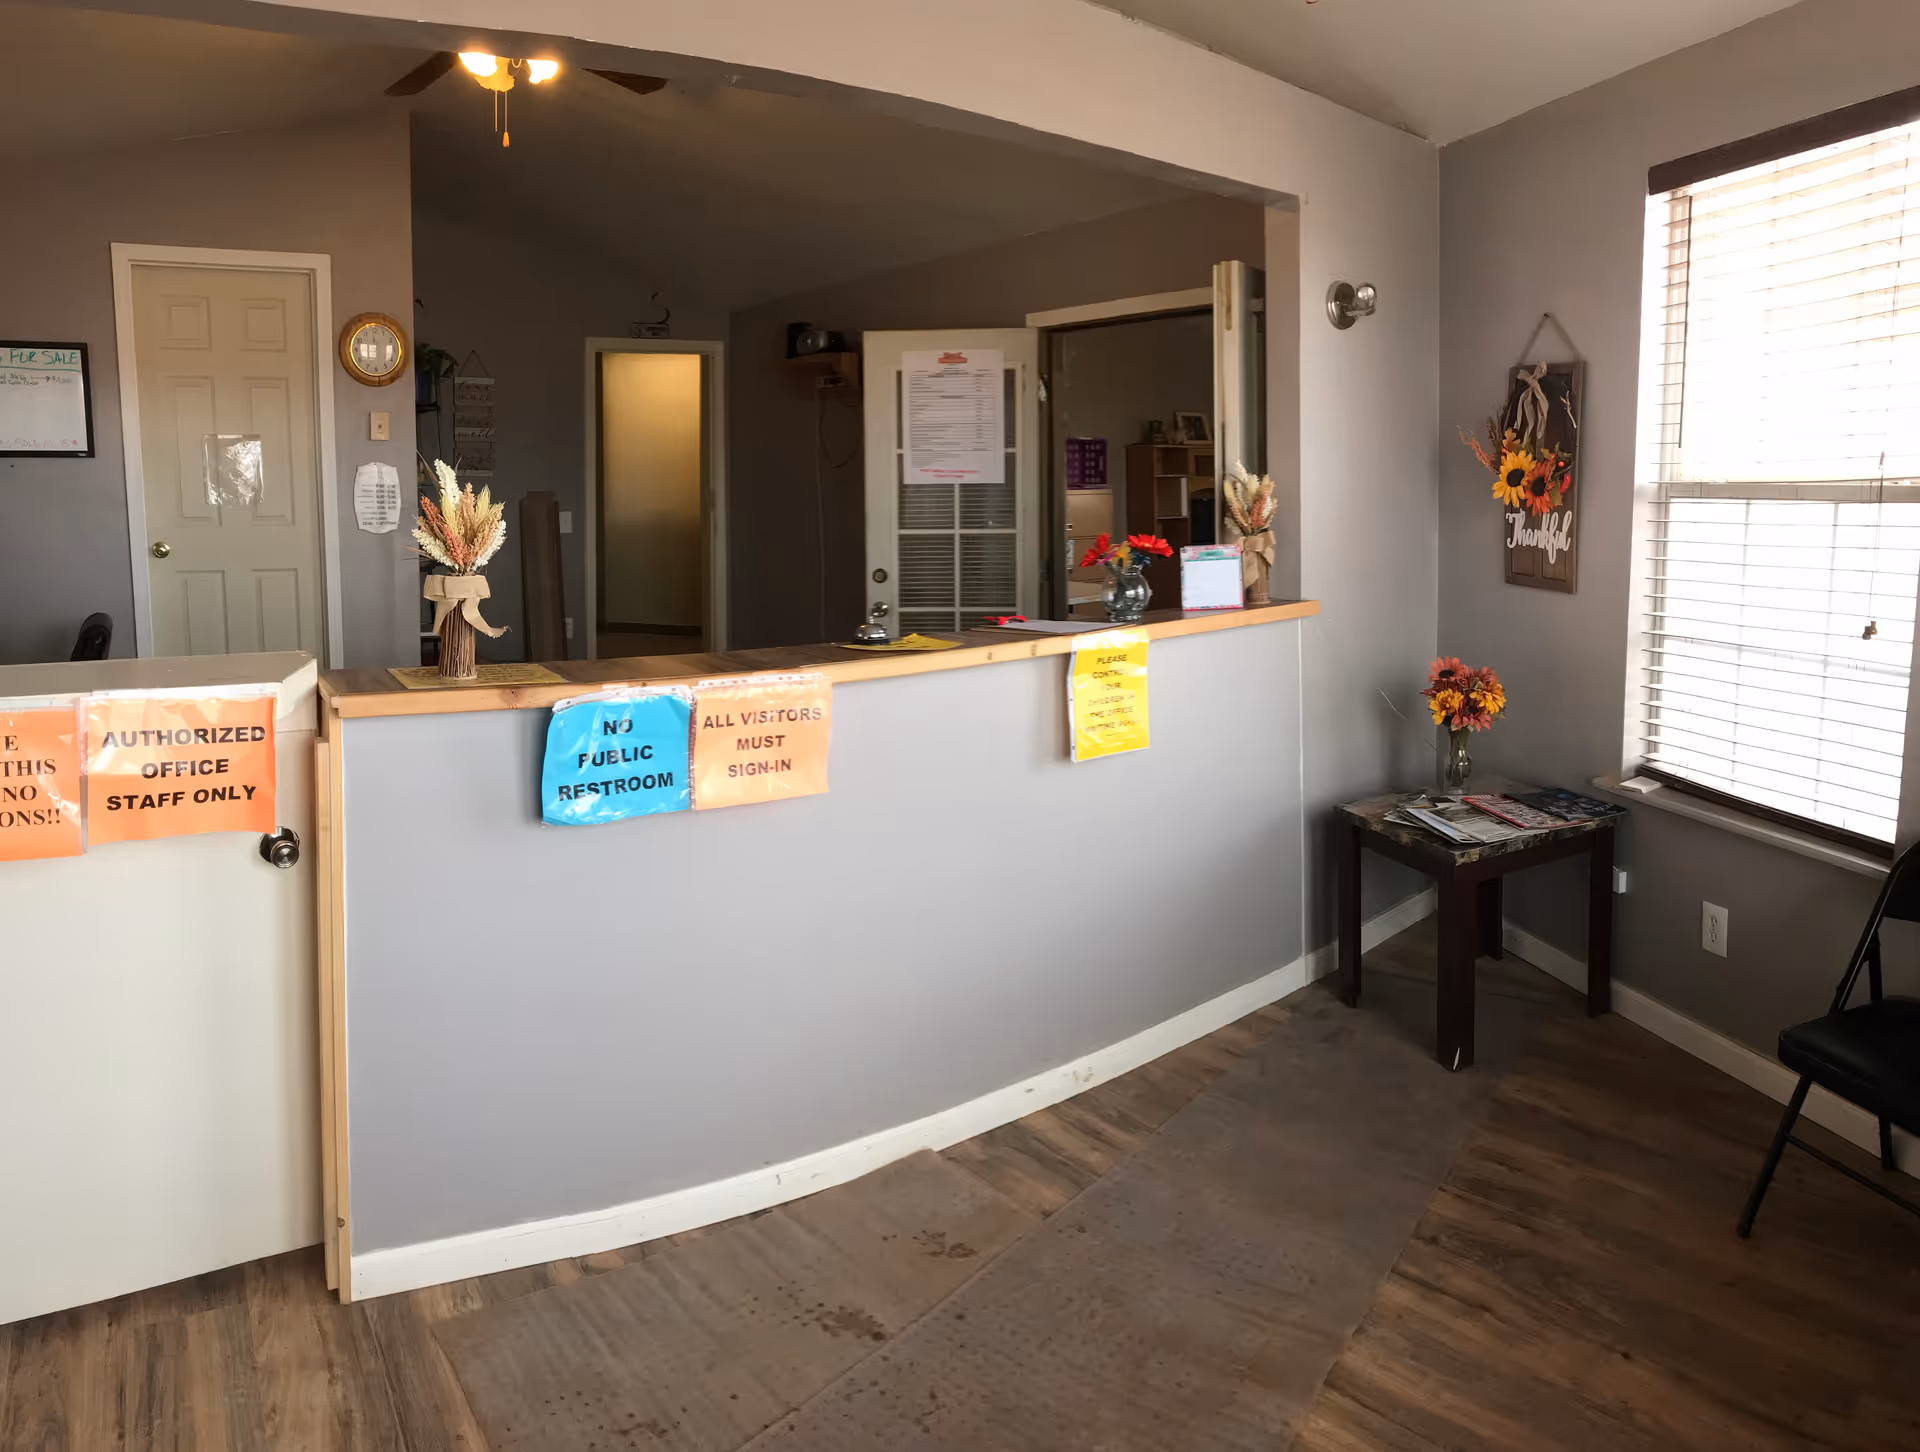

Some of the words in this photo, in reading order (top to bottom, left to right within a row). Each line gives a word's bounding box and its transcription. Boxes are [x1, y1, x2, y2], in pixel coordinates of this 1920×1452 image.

[42, 350, 79, 365] SALE
[1505, 508, 1572, 564] Thankful
[1096, 654, 1128, 665] PLEASE
[603, 718, 634, 736] NO
[703, 714, 735, 729] ALL
[741, 707, 823, 726] VISITORS
[0, 735, 18, 751] E
[102, 726, 265, 748] AUTHORIZED
[736, 735, 786, 751] MUST
[578, 745, 654, 769] PUBLIC
[0, 759, 56, 777] THIS
[141, 759, 229, 779] OFFICE
[728, 759, 792, 778] SIGN-IN
[2, 785, 37, 802] NO
[558, 771, 674, 801] RESTROOM
[107, 792, 186, 811] STAFF
[193, 785, 257, 804] ONLY
[0, 808, 60, 827] ONS!!
